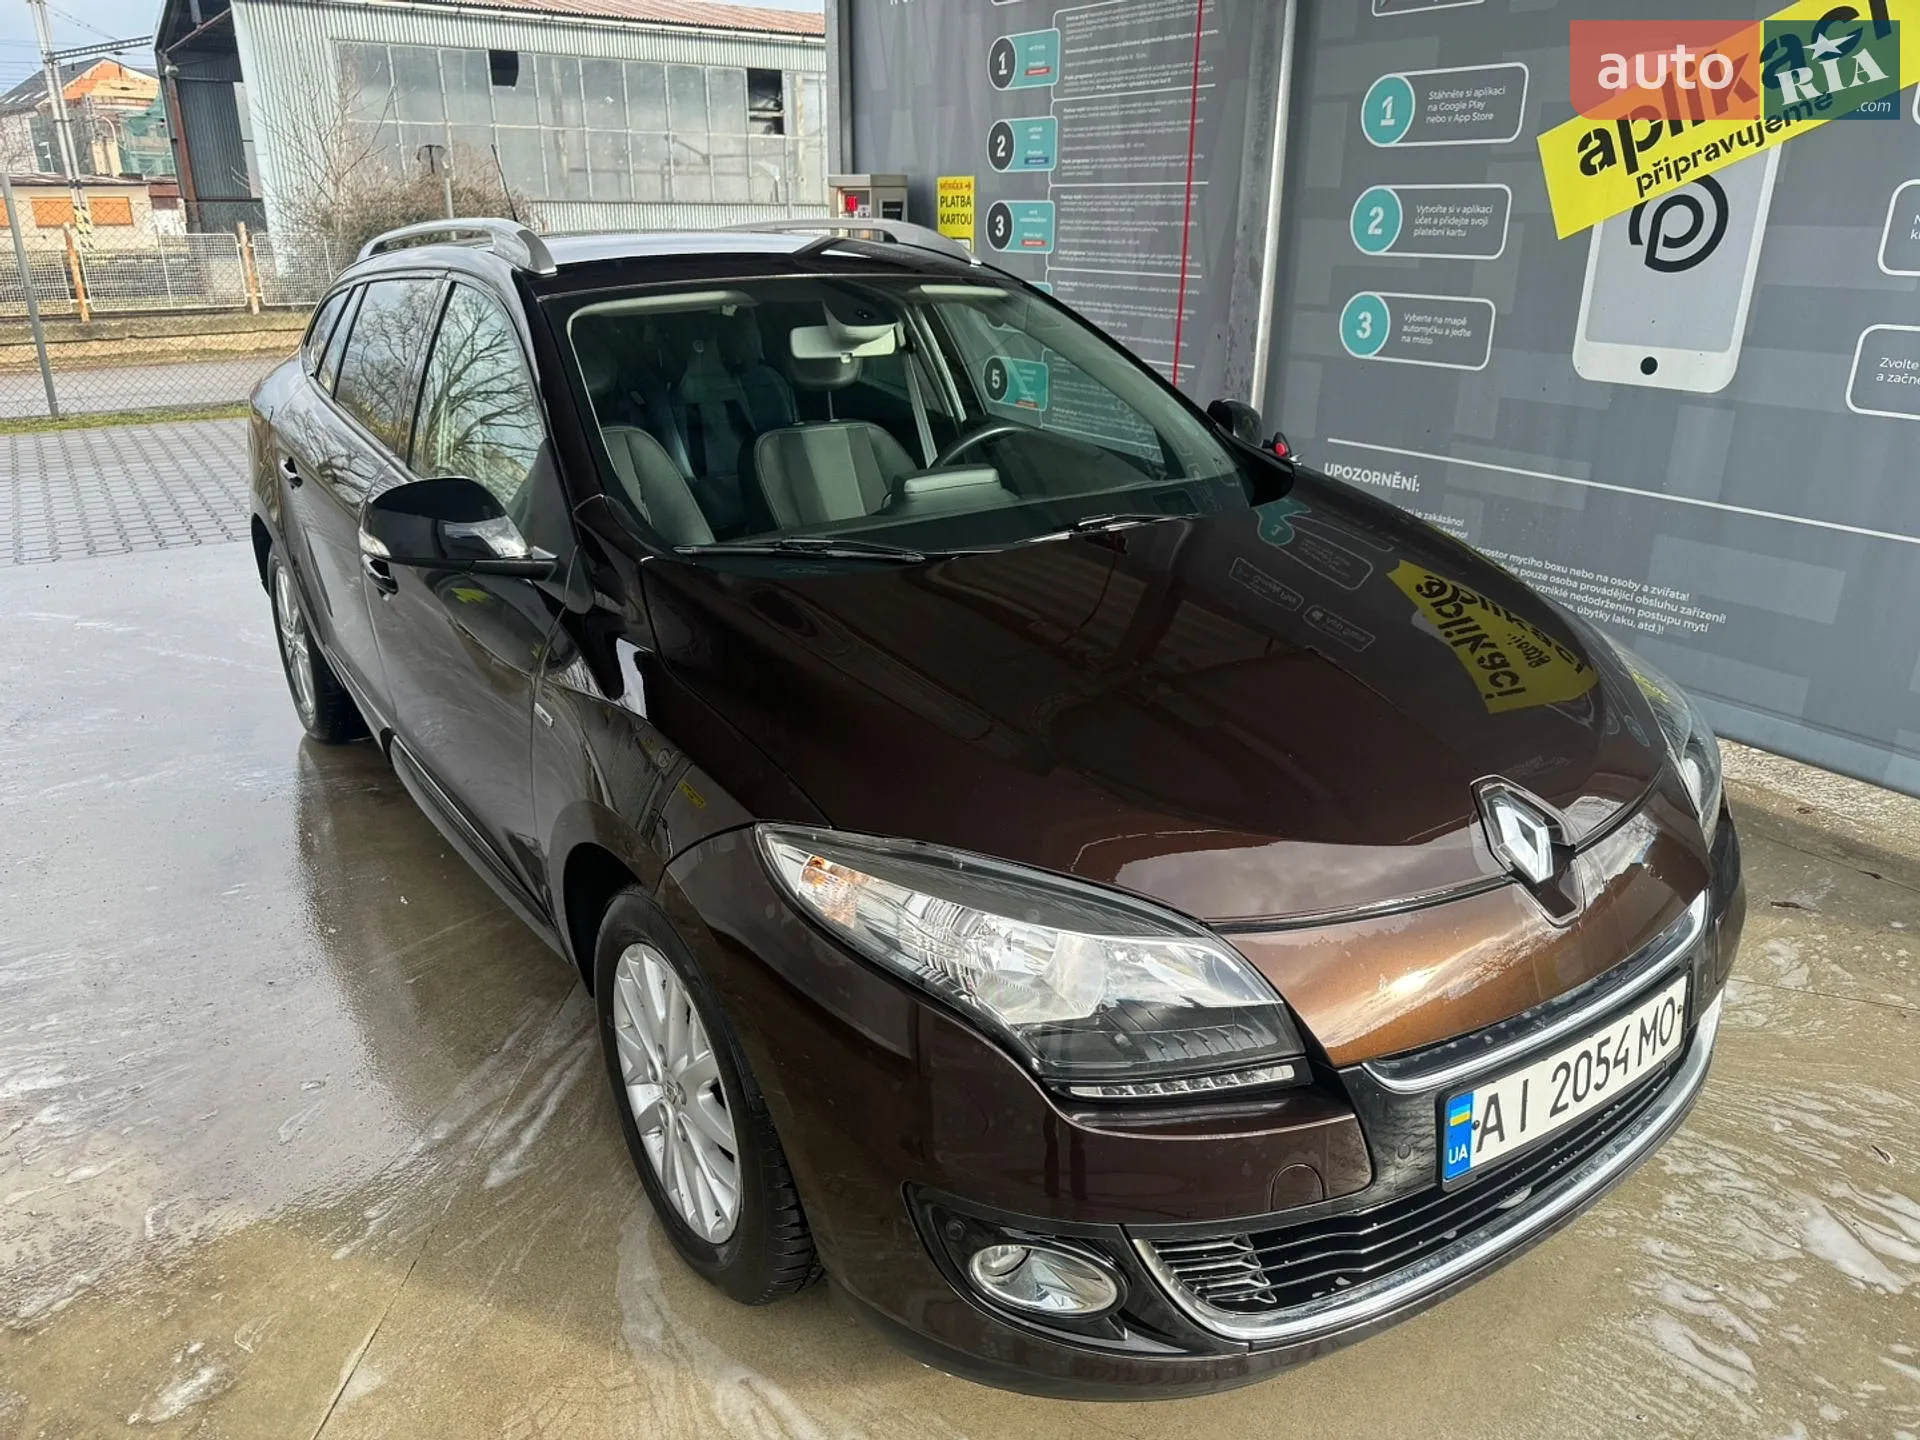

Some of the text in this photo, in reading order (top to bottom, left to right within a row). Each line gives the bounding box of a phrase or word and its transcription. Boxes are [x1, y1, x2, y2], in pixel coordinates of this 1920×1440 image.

[997, 51, 1008, 75] 1
[1380, 95, 1396, 127] 1
[1425, 113, 1447, 124] nebo
[1453, 113, 1471, 123] App
[1472, 111, 1494, 121] Store
[1427, 100, 1487, 112] na Google Play
[996, 135, 1006, 158] 2
[1635, 91, 1833, 198] připravujeme
[940, 195, 972, 208] PLATBA
[940, 212, 972, 225] KARTOU
[994, 214, 1005, 238] 3
[1367, 206, 1384, 236] 2
[1356, 311, 1373, 339] 3
[1879, 357, 1919, 370] Zvolte
[991, 369, 1001, 389] 5
[1875, 373, 1884, 382] a
[1323, 462, 1421, 493] UPOZORNĚNÍ:
[1544, 560, 1568, 574] boxu
[1569, 567, 1595, 580] nebo
[1595, 573, 1609, 583] na
[1610, 577, 1641, 592] osoby
[1641, 584, 1649, 593] a
[1650, 585, 1690, 601] zvířata!
[1520, 568, 1548, 581] pouze
[1549, 575, 1578, 588] osoba
[1635, 595, 1679, 612] obsluhu
[1680, 605, 1728, 624] zařízení!
[1569, 592, 1636, 615] nedodržením
[1637, 609, 1682, 626] postupu
[1683, 620, 1710, 633] mytí
[1475, 996, 1676, 1154] AI 2054 MO
[1448, 1147, 1469, 1165] UA
